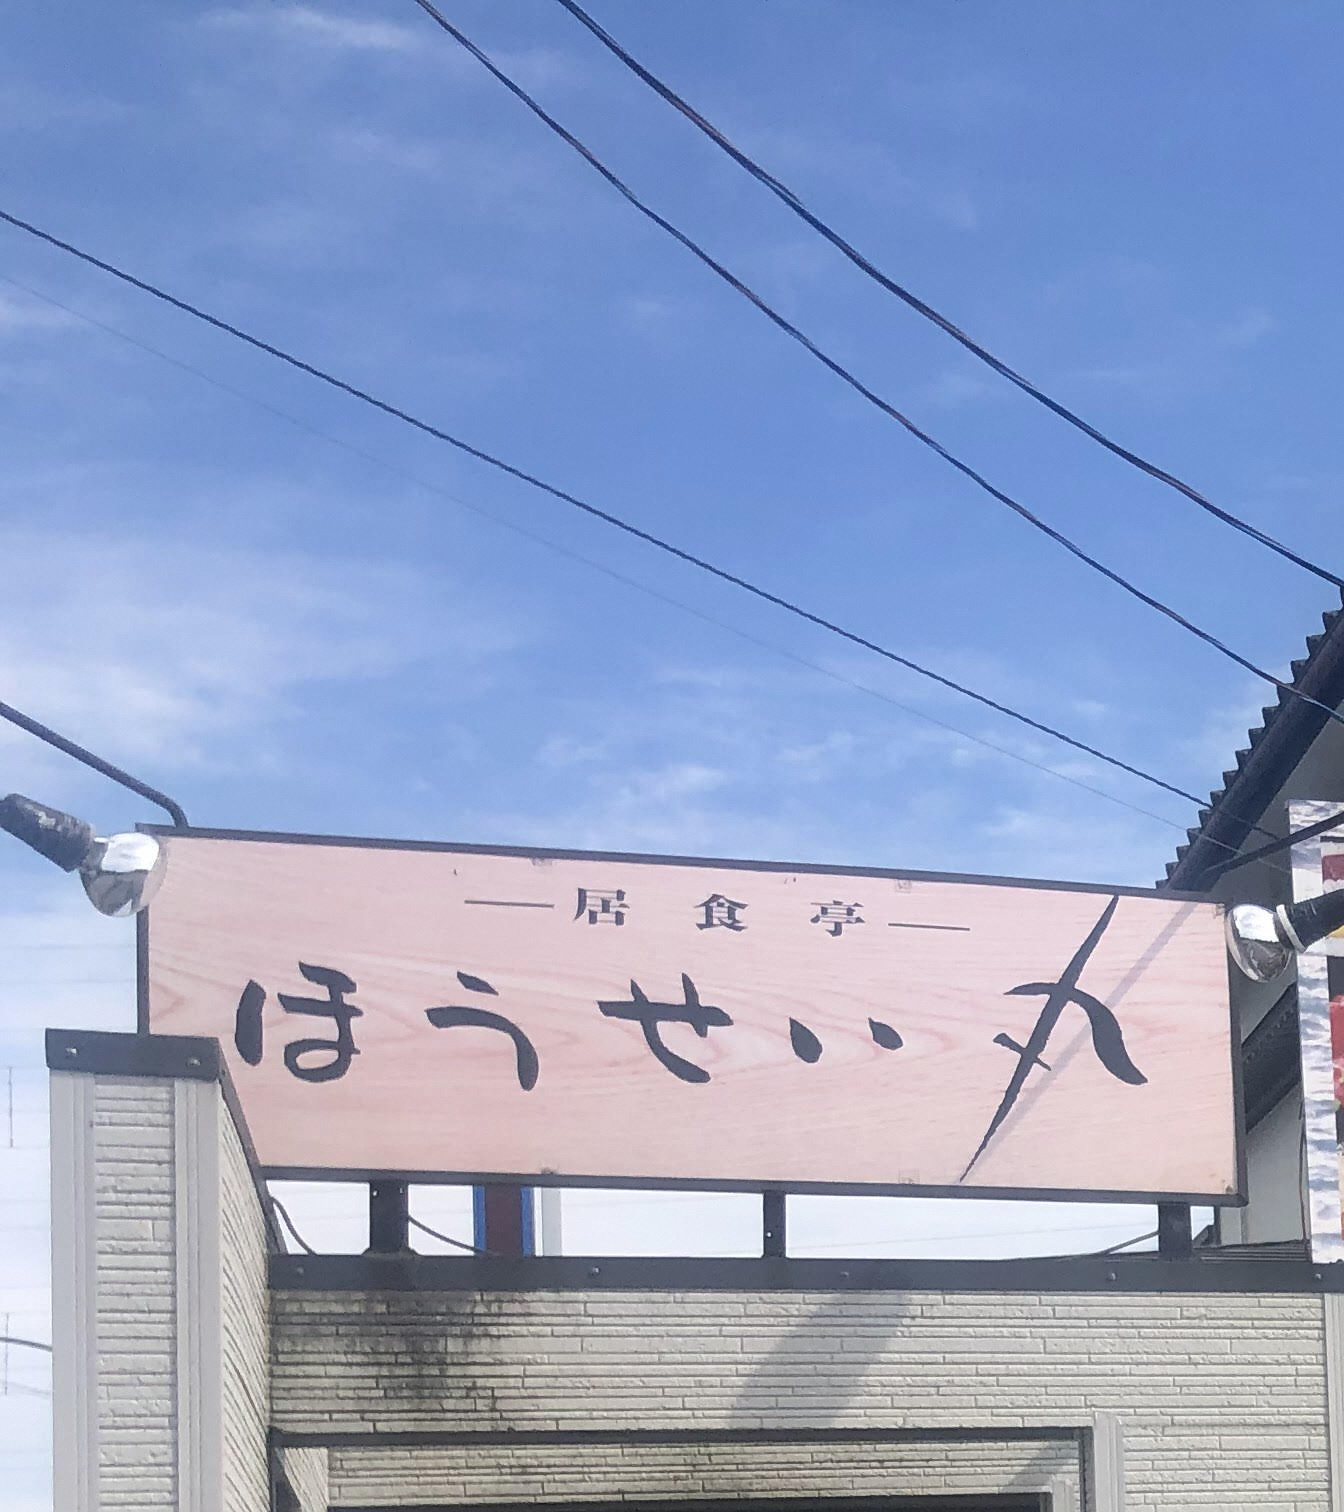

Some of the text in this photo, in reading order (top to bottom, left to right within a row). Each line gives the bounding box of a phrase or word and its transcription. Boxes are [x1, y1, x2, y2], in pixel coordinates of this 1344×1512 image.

[236, 894, 1147, 1183] ほうせい丸
